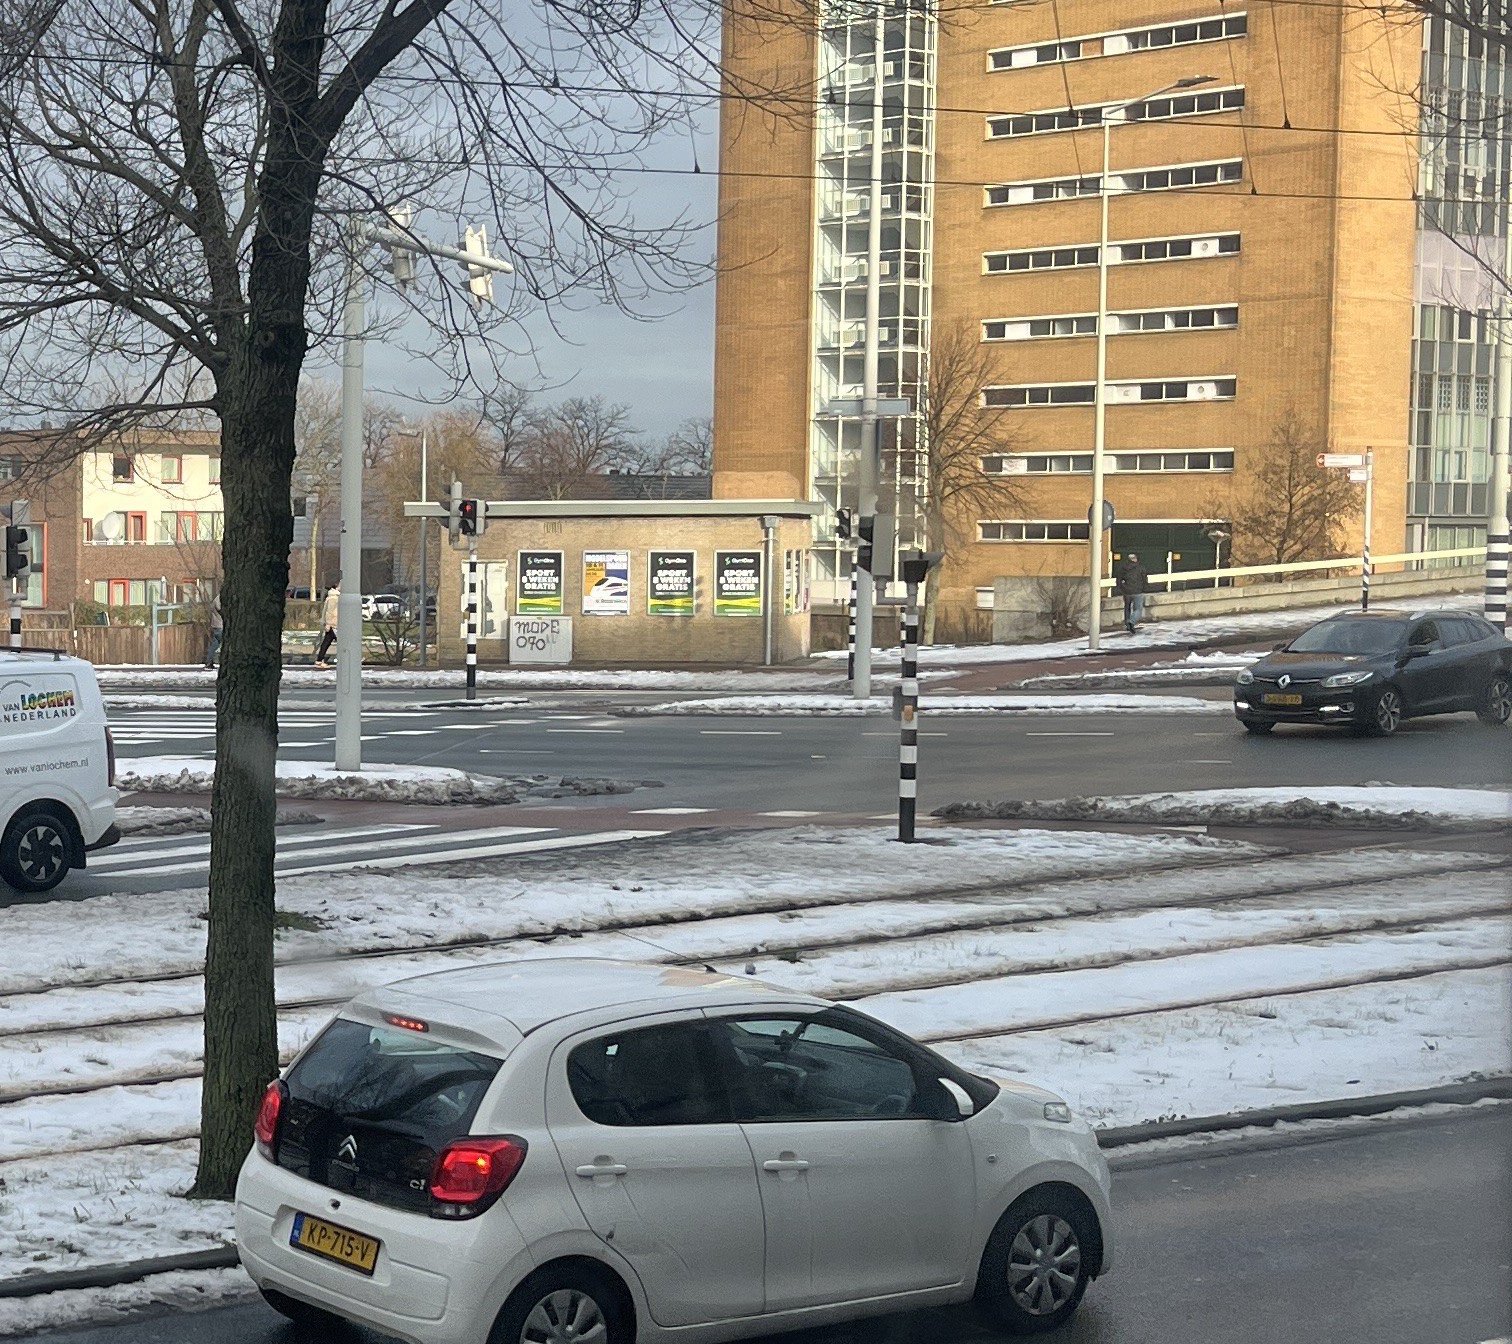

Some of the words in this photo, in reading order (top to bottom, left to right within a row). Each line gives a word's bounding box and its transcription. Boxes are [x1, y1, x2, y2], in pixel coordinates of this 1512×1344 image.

[529, 576, 559, 584] WEKEN
[2, 702, 20, 712] VAN
[20, 690, 75, 711] LOCHEM
[4, 708, 76, 723] NEDERLAND
[4, 758, 88, 775] www.vanlochem.nl
[307, 1223, 370, 1261] KP-715-V
